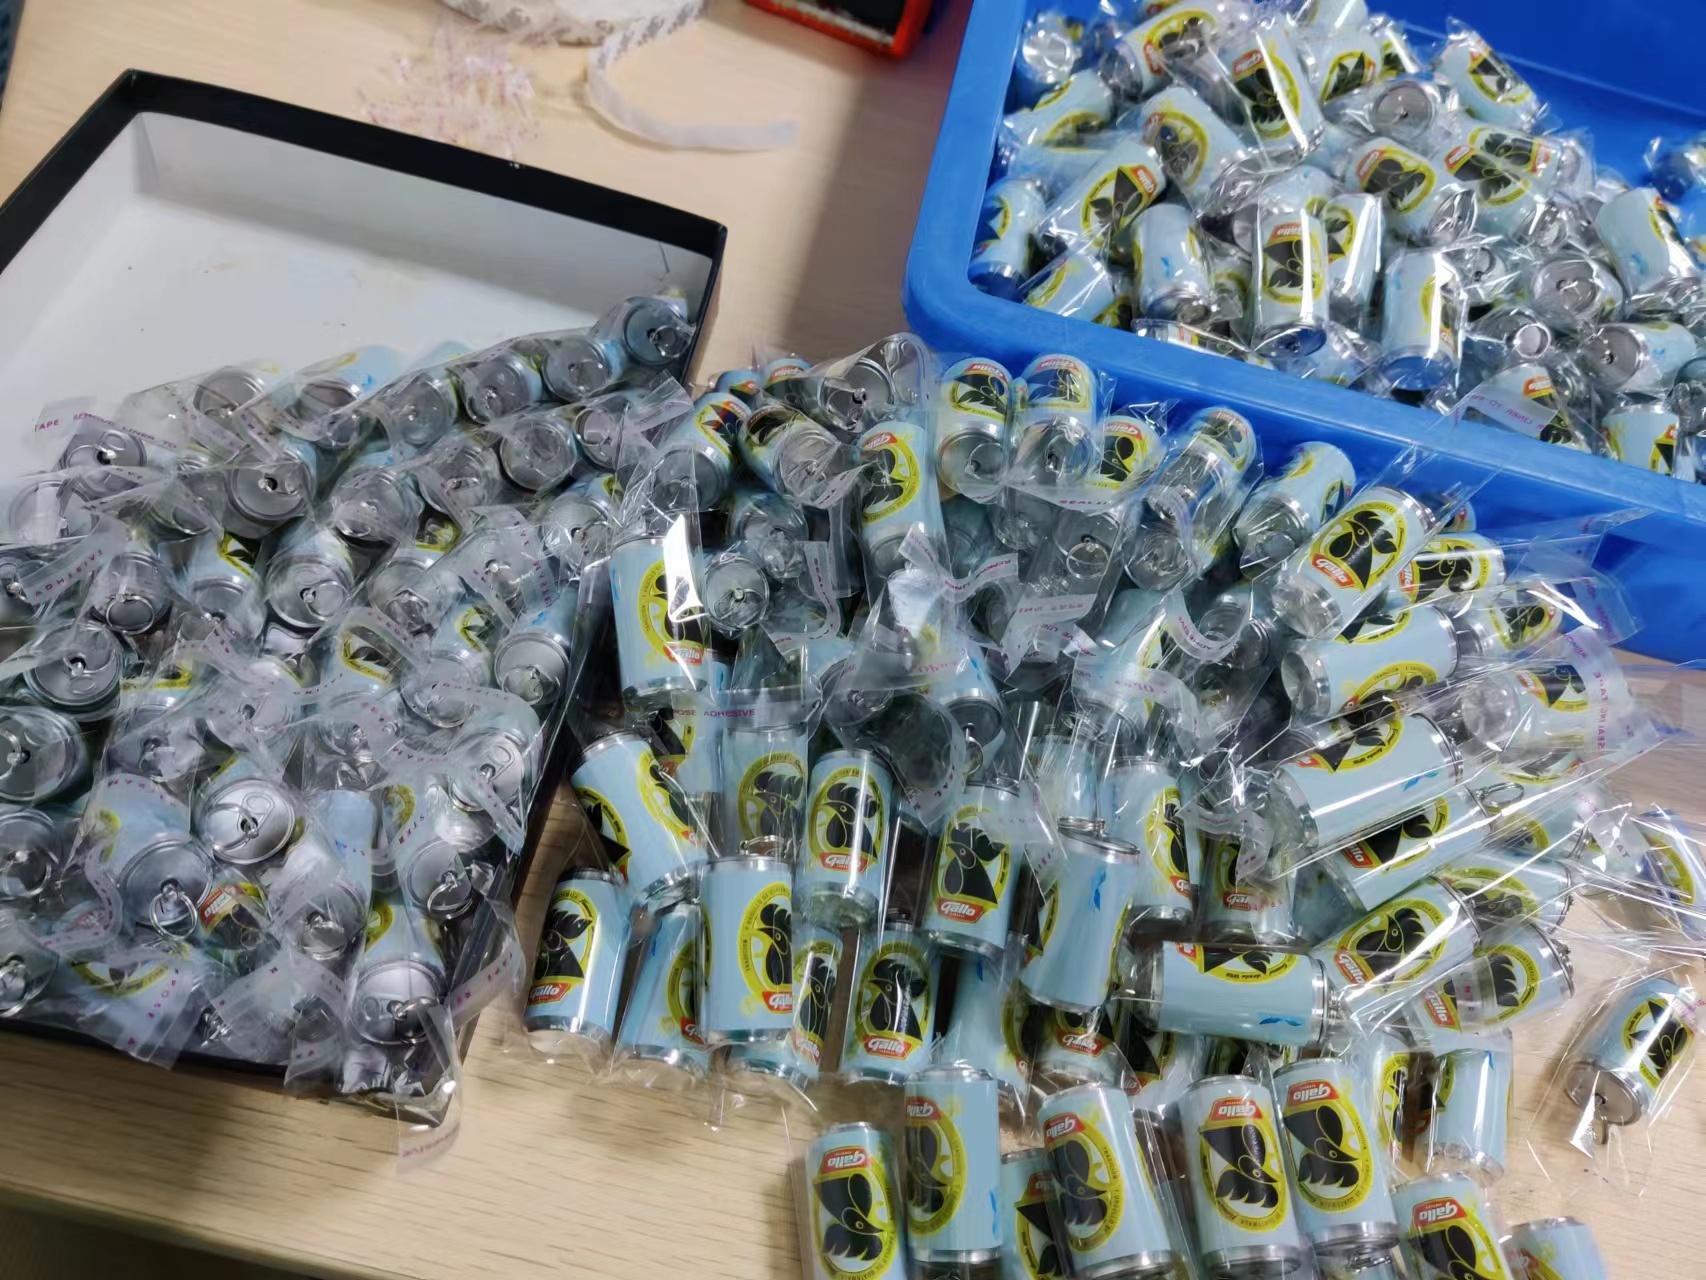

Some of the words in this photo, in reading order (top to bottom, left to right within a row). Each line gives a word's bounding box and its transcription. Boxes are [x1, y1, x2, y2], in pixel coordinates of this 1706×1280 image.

[703, 708, 756, 718] ADHESIVE
[940, 900, 976, 918] Gallo
[867, 1038, 906, 1054] Gallo
[1293, 1083, 1331, 1102] Gallo
[1218, 1101, 1257, 1118] Gallo
[1046, 1117, 1076, 1138] Gallo
[827, 1150, 866, 1169] Gallo
[1418, 1201, 1458, 1223] Gallo
